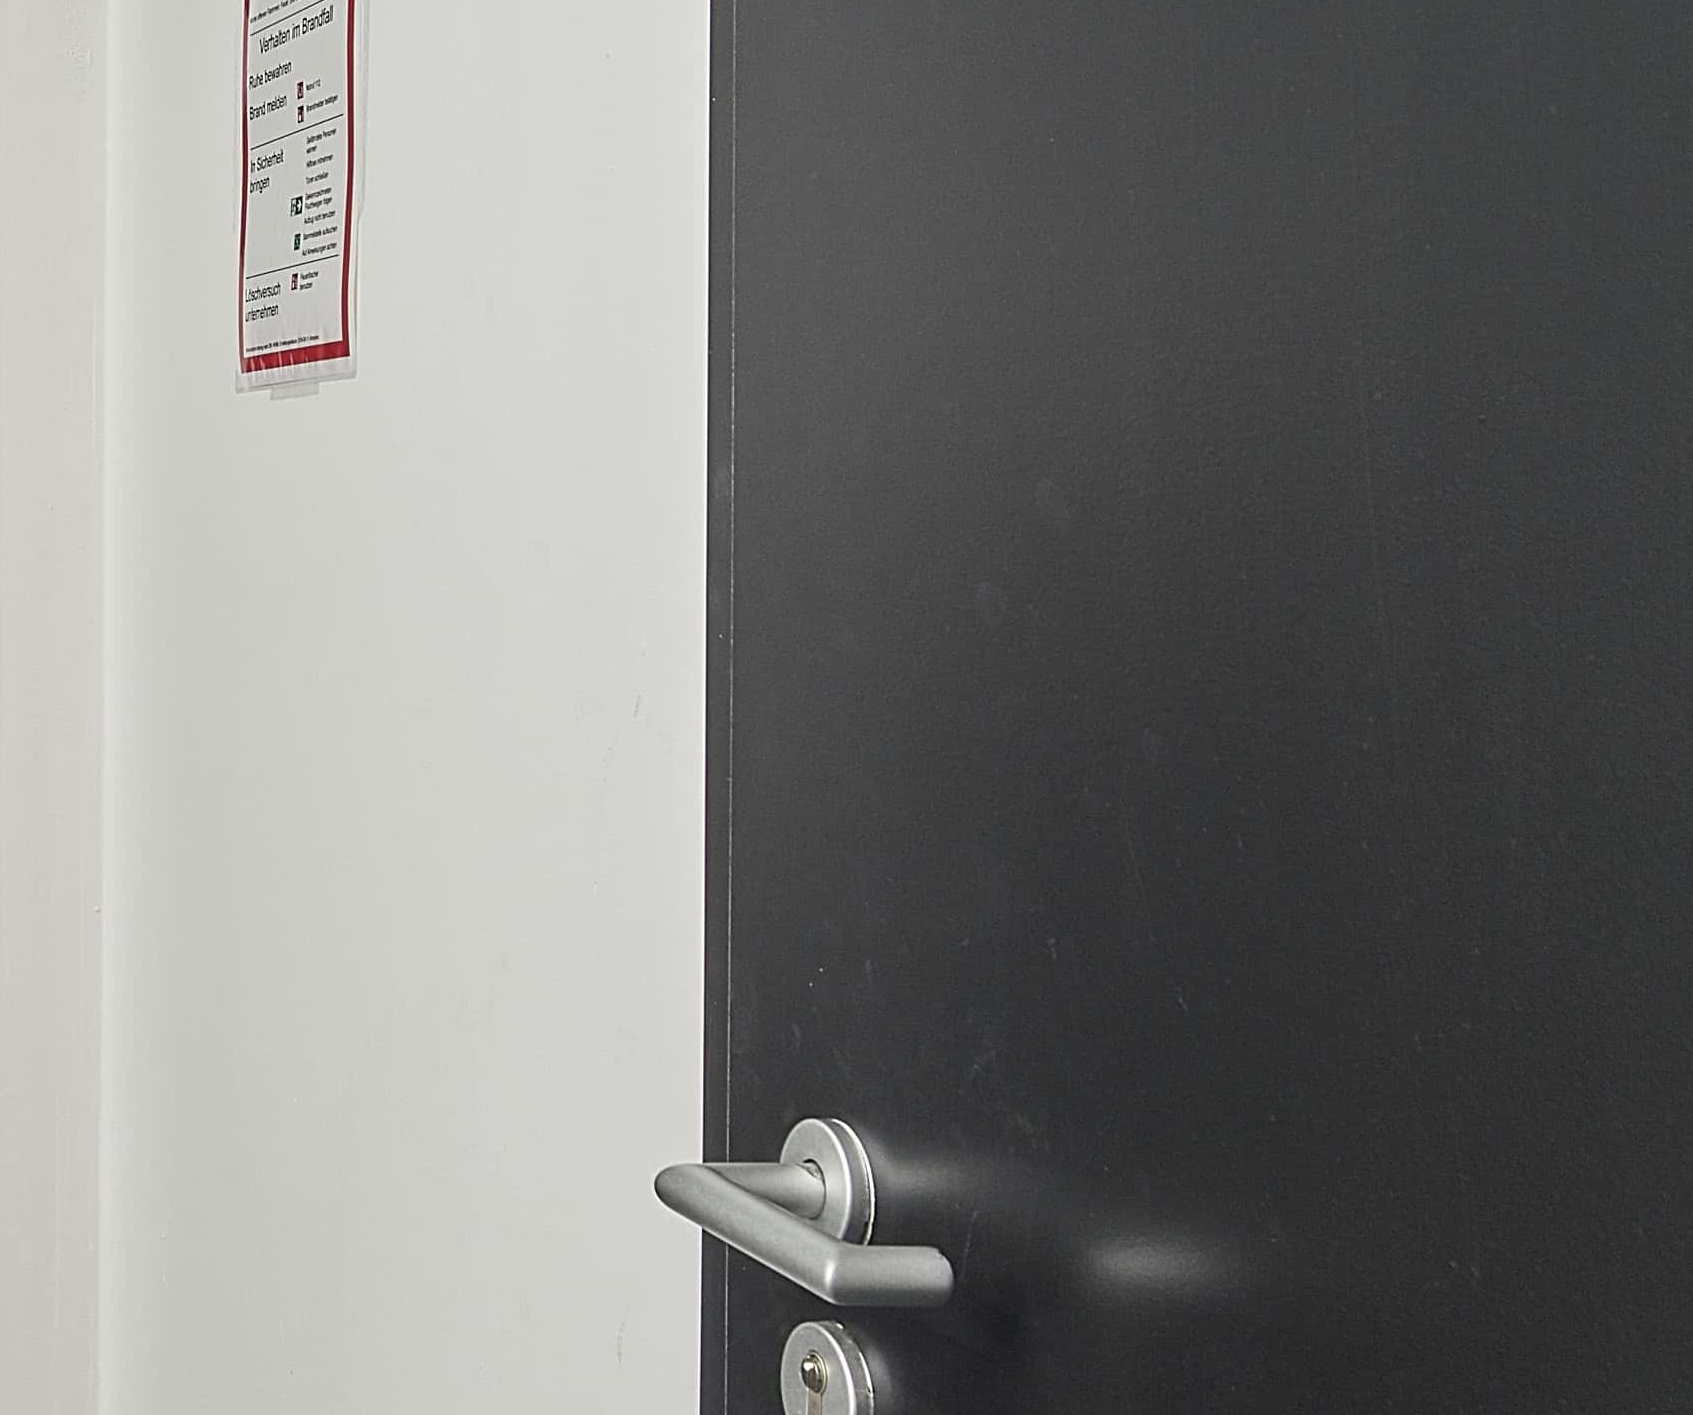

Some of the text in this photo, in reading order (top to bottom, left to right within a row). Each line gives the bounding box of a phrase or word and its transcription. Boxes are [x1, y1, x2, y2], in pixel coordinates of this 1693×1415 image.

[259, 4, 334, 54] Verhalten im Brandfall
[249, 61, 292, 90] Ruhe bewahren
[249, 101, 266, 120] Brand
[266, 95, 288, 115] melden
